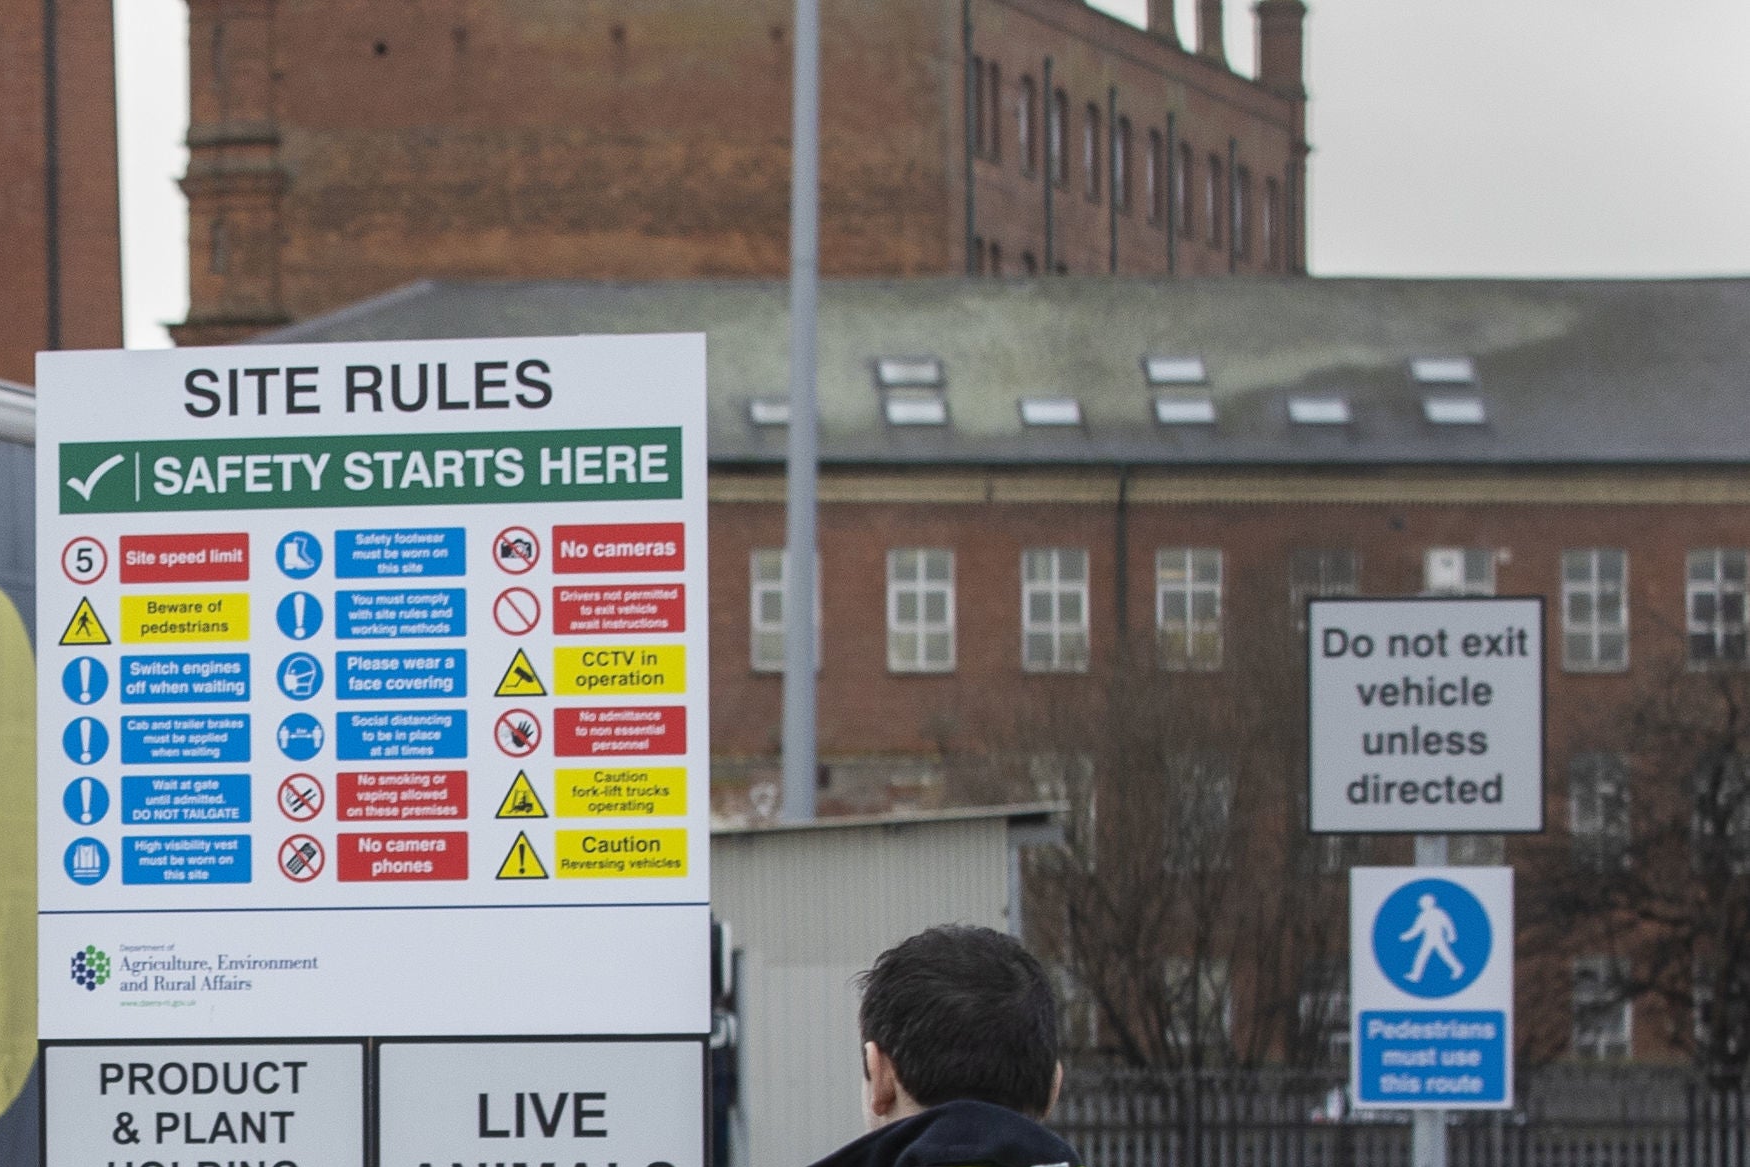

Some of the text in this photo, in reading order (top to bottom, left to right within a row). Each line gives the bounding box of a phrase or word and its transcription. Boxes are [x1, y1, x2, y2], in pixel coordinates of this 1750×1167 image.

[184, 359, 554, 418] SITE RULES
[153, 444, 669, 496] SAFETY STARTS HERE
[355, 533, 445, 547] Safety footwear
[352, 549, 449, 560] must be worn on
[560, 541, 677, 559] No cameras
[76, 548, 93, 573] 5
[126, 549, 243, 567] Site speed limit
[377, 563, 424, 574] this site
[352, 593, 450, 606] You must comply
[560, 589, 678, 602] Drivers not permitted
[147, 600, 223, 614] Beware of
[348, 608, 453, 620] with site rules and
[580, 604, 658, 615] to exit vehicle
[141, 620, 229, 636] pedestrians
[351, 623, 450, 637] working methods
[570, 618, 669, 630] await instructions
[1323, 626, 1529, 658] Do not exit
[348, 656, 455, 670] Please wear a
[582, 650, 658, 667] CCTV in
[130, 661, 241, 677] Switch engines
[348, 676, 454, 692] face covering
[575, 671, 665, 690] operation
[126, 680, 245, 696] off when waiting
[1357, 676, 1493, 707] vehicle
[351, 714, 453, 728] Social distancing
[580, 710, 662, 722] No admittance
[127, 719, 244, 731] Cab and trailer brakes
[575, 725, 665, 737] to non essential
[143, 733, 228, 746] must be applied
[362, 729, 441, 742] to be in place
[1362, 725, 1489, 756] unless
[151, 747, 220, 759] when waiting
[370, 745, 434, 756] at all times
[592, 739, 649, 753] personnel
[358, 774, 446, 787] No smoking or
[593, 771, 648, 783] Caution
[153, 780, 220, 792] Wait at gate
[572, 786, 670, 798] fork-lift trucks
[1347, 774, 1503, 805] directed
[145, 794, 226, 806] until admitted.
[357, 789, 448, 803] vaping allowed
[133, 808, 240, 821] DO NOT TAILGATE
[346, 804, 458, 818] on these premises
[588, 801, 654, 815] operating
[135, 840, 238, 852] High visibility vest
[358, 838, 446, 853] No camera
[582, 836, 661, 854] Caution
[139, 855, 234, 866] must be worn on
[372, 859, 433, 876] phones
[561, 858, 681, 871] Reversing vehicles
[163, 870, 209, 880] this site
[119, 954, 318, 977] Agriculture, Environment
[119, 975, 253, 992] and Rural Affairs
[1368, 1019, 1496, 1040] Pedestrians
[1382, 1048, 1482, 1067] must use
[99, 1061, 308, 1096] PRODUCT
[1380, 1073, 1483, 1094] this route
[477, 1092, 608, 1138] LIVE
[112, 1111, 295, 1145] & PLANT
